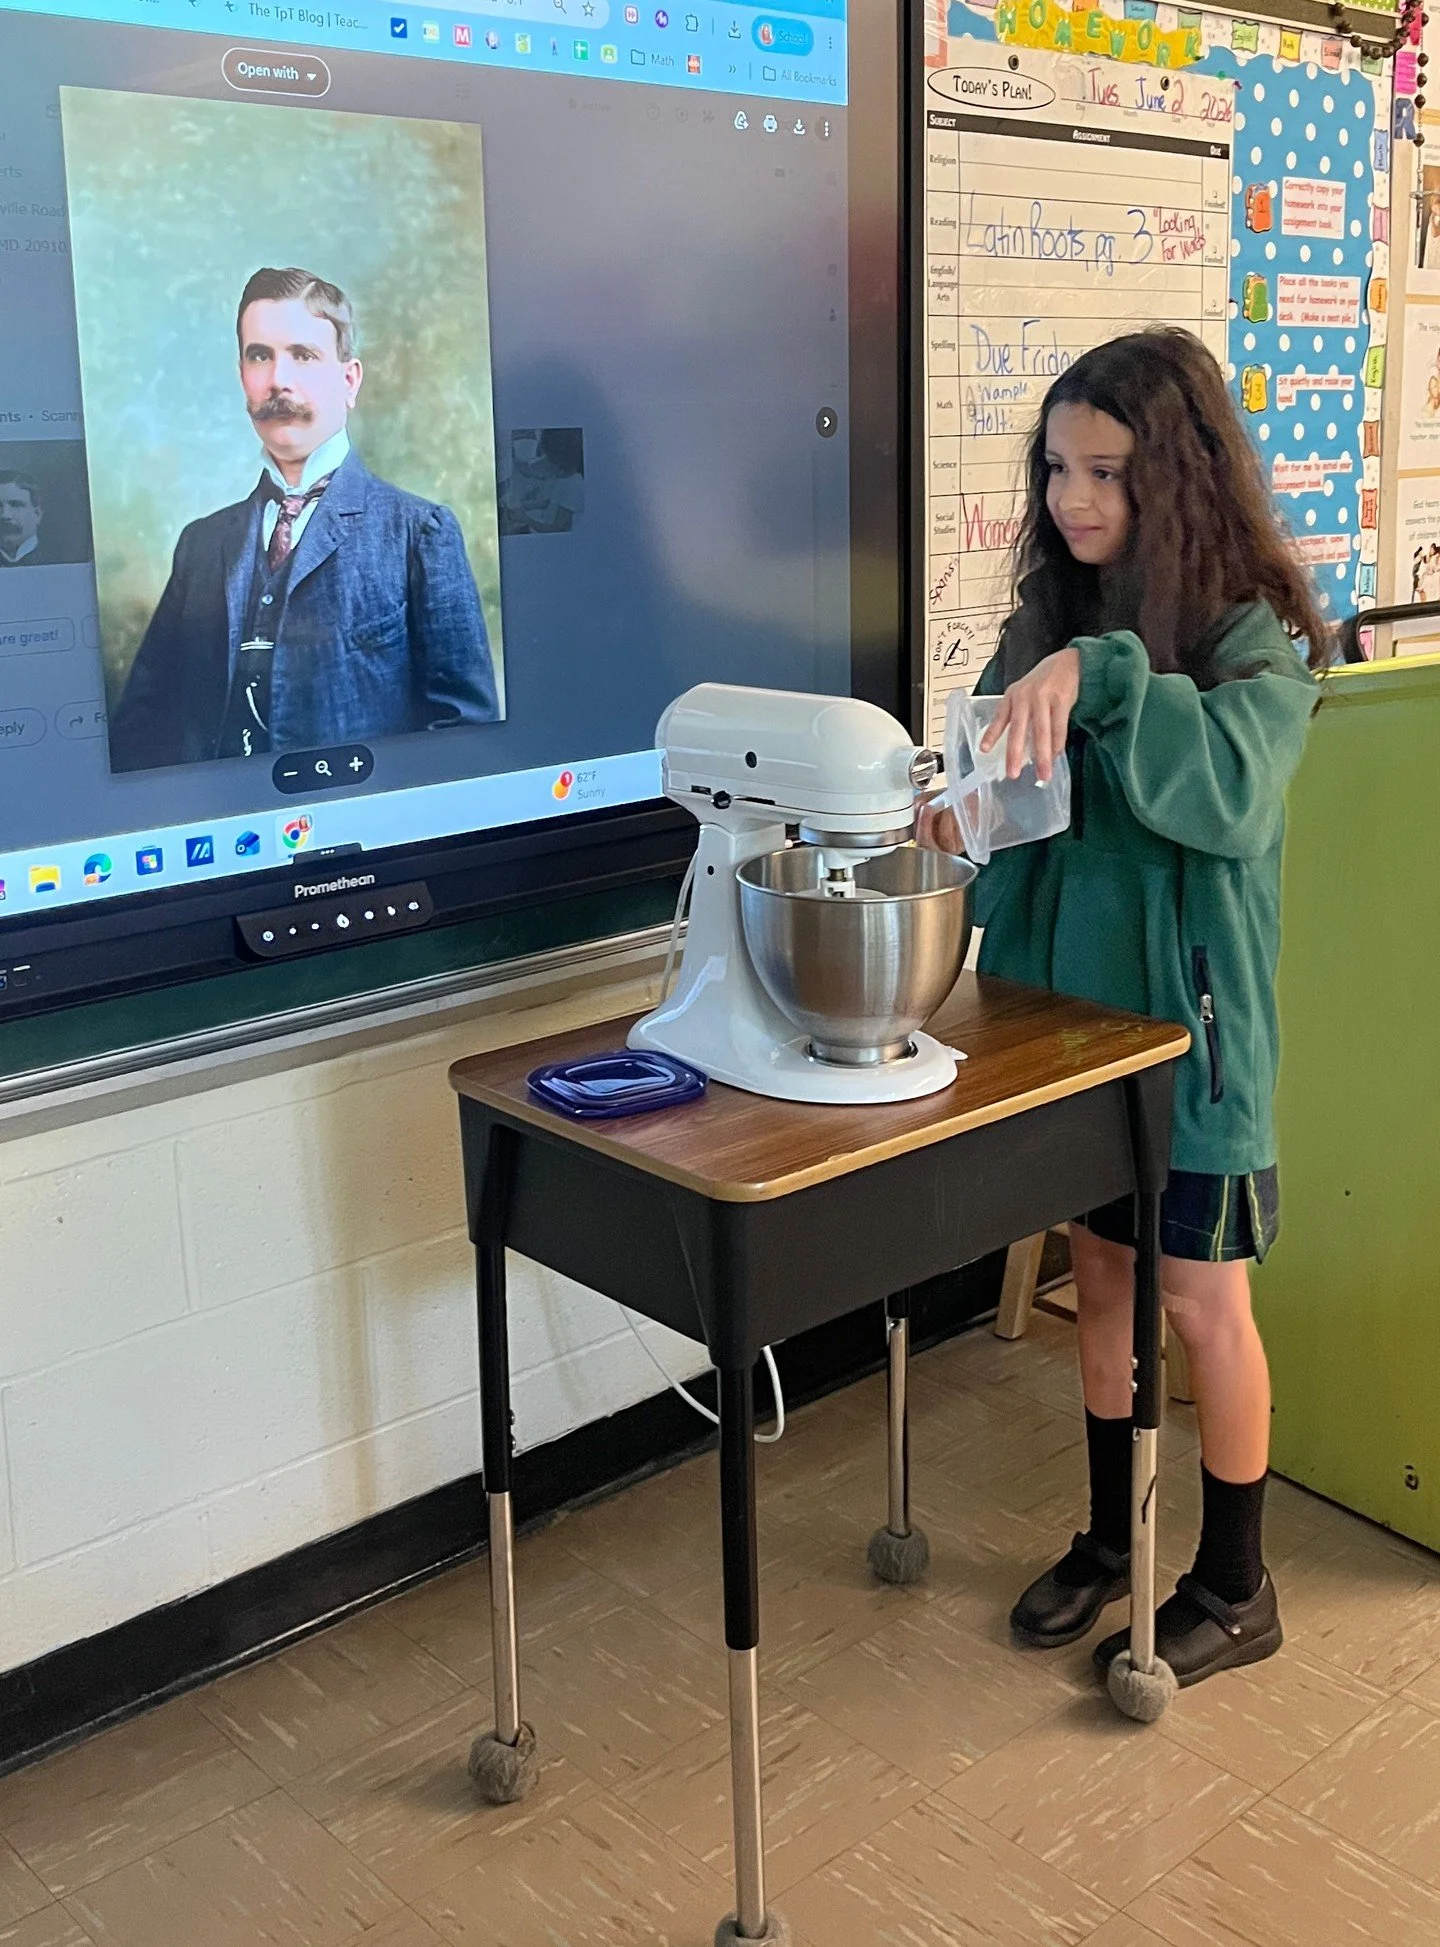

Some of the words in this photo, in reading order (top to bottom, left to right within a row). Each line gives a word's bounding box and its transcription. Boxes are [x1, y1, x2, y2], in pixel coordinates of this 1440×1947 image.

[249, 2, 270, 17] The
[274, 6, 294, 22] TpT
[298, 9, 324, 27] Blog
[778, 31, 806, 44] School
[651, 54, 675, 67] Math
[237, 61, 270, 78] Open
[273, 65, 299, 80] with
[781, 69, 792, 81] All
[794, 71, 837, 87] Bookmarks
[1135, 76, 1167, 112] June
[929, 154, 957, 168] Religion
[1285, 180, 1314, 194] Correctly
[31, 203, 65, 217] Road
[929, 217, 957, 230] Reading
[967, 189, 1025, 257] Latin
[1127, 208, 1154, 264] 3
[24, 239, 67, 254] 20910
[930, 340, 956, 352] Spelling
[970, 324, 1013, 375] Due
[936, 400, 953, 410] Math
[932, 461, 957, 470] Science
[935, 512, 955, 522] Social
[933, 526, 956, 535] Studies
[20, 630, 58, 648] great!
[577, 787, 606, 800] Sunny
[294, 873, 376, 899] Promethean
